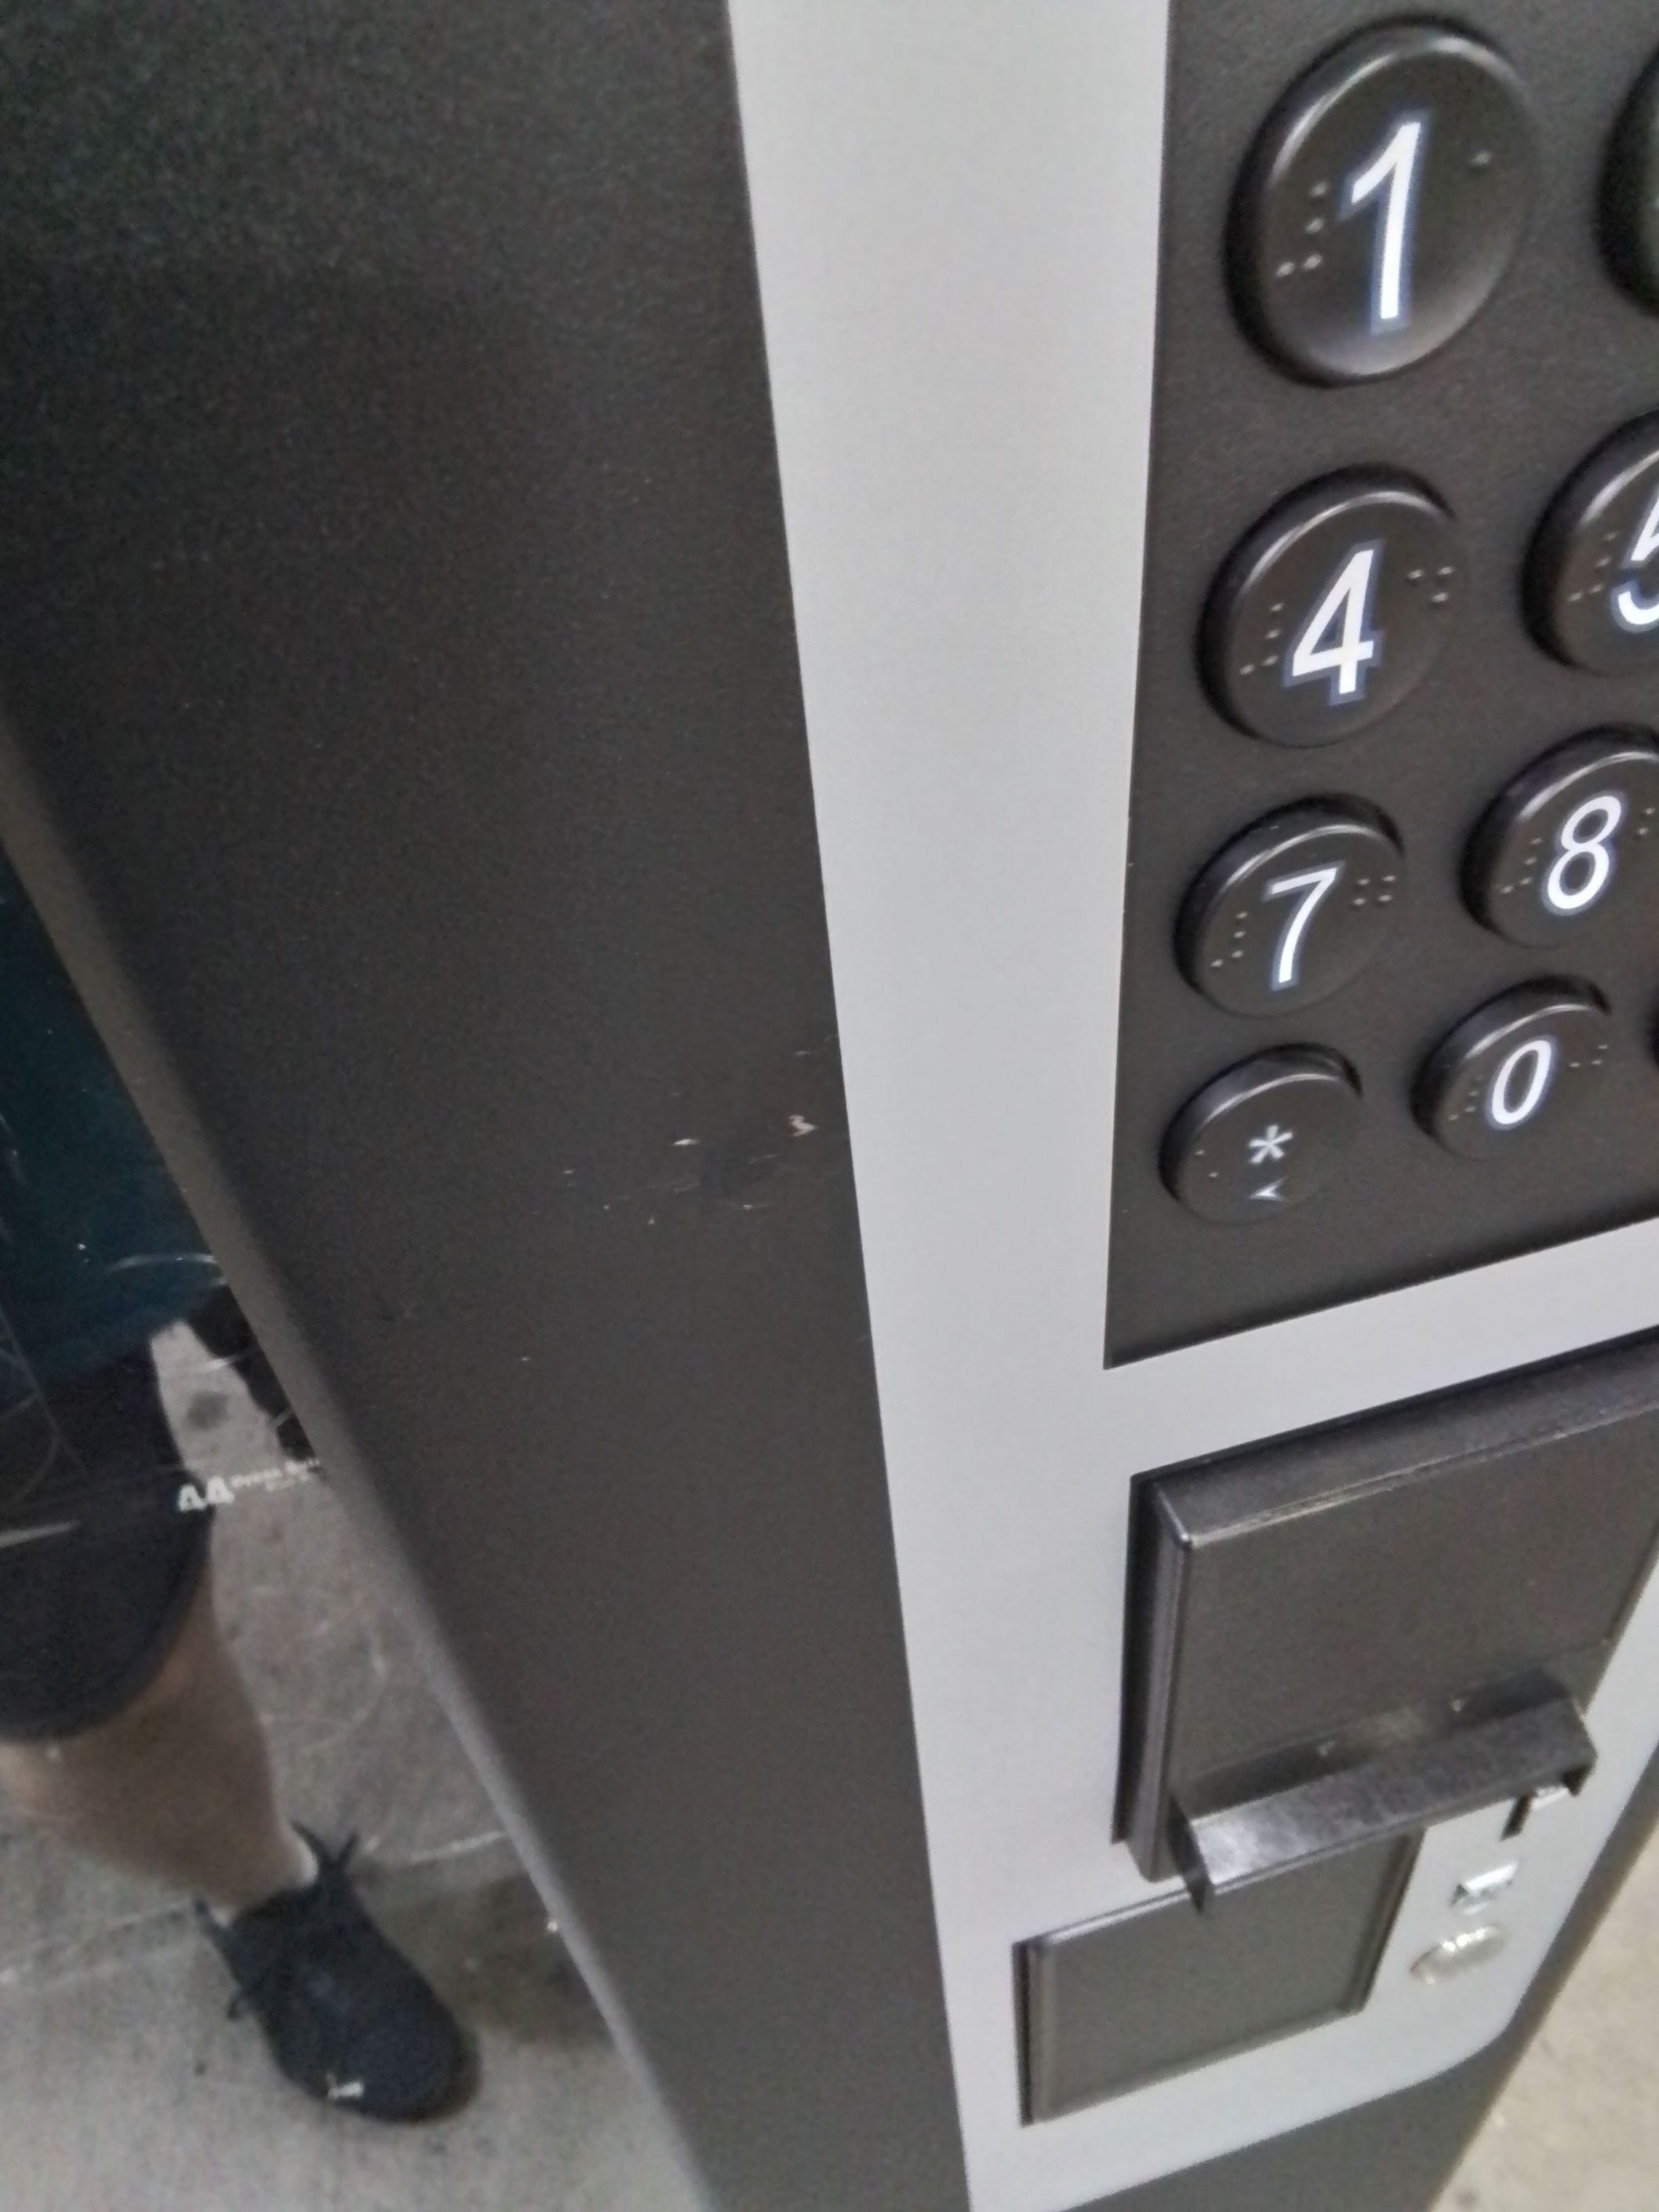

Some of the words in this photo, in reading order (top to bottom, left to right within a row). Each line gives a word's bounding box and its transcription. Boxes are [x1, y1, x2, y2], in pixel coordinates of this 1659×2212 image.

[1350, 120, 1422, 321] 1
[1291, 548, 1375, 697] 4
[1547, 794, 1623, 911] 8
[1268, 866, 1339, 985] 7
[1490, 1038, 1552, 1126] 0
